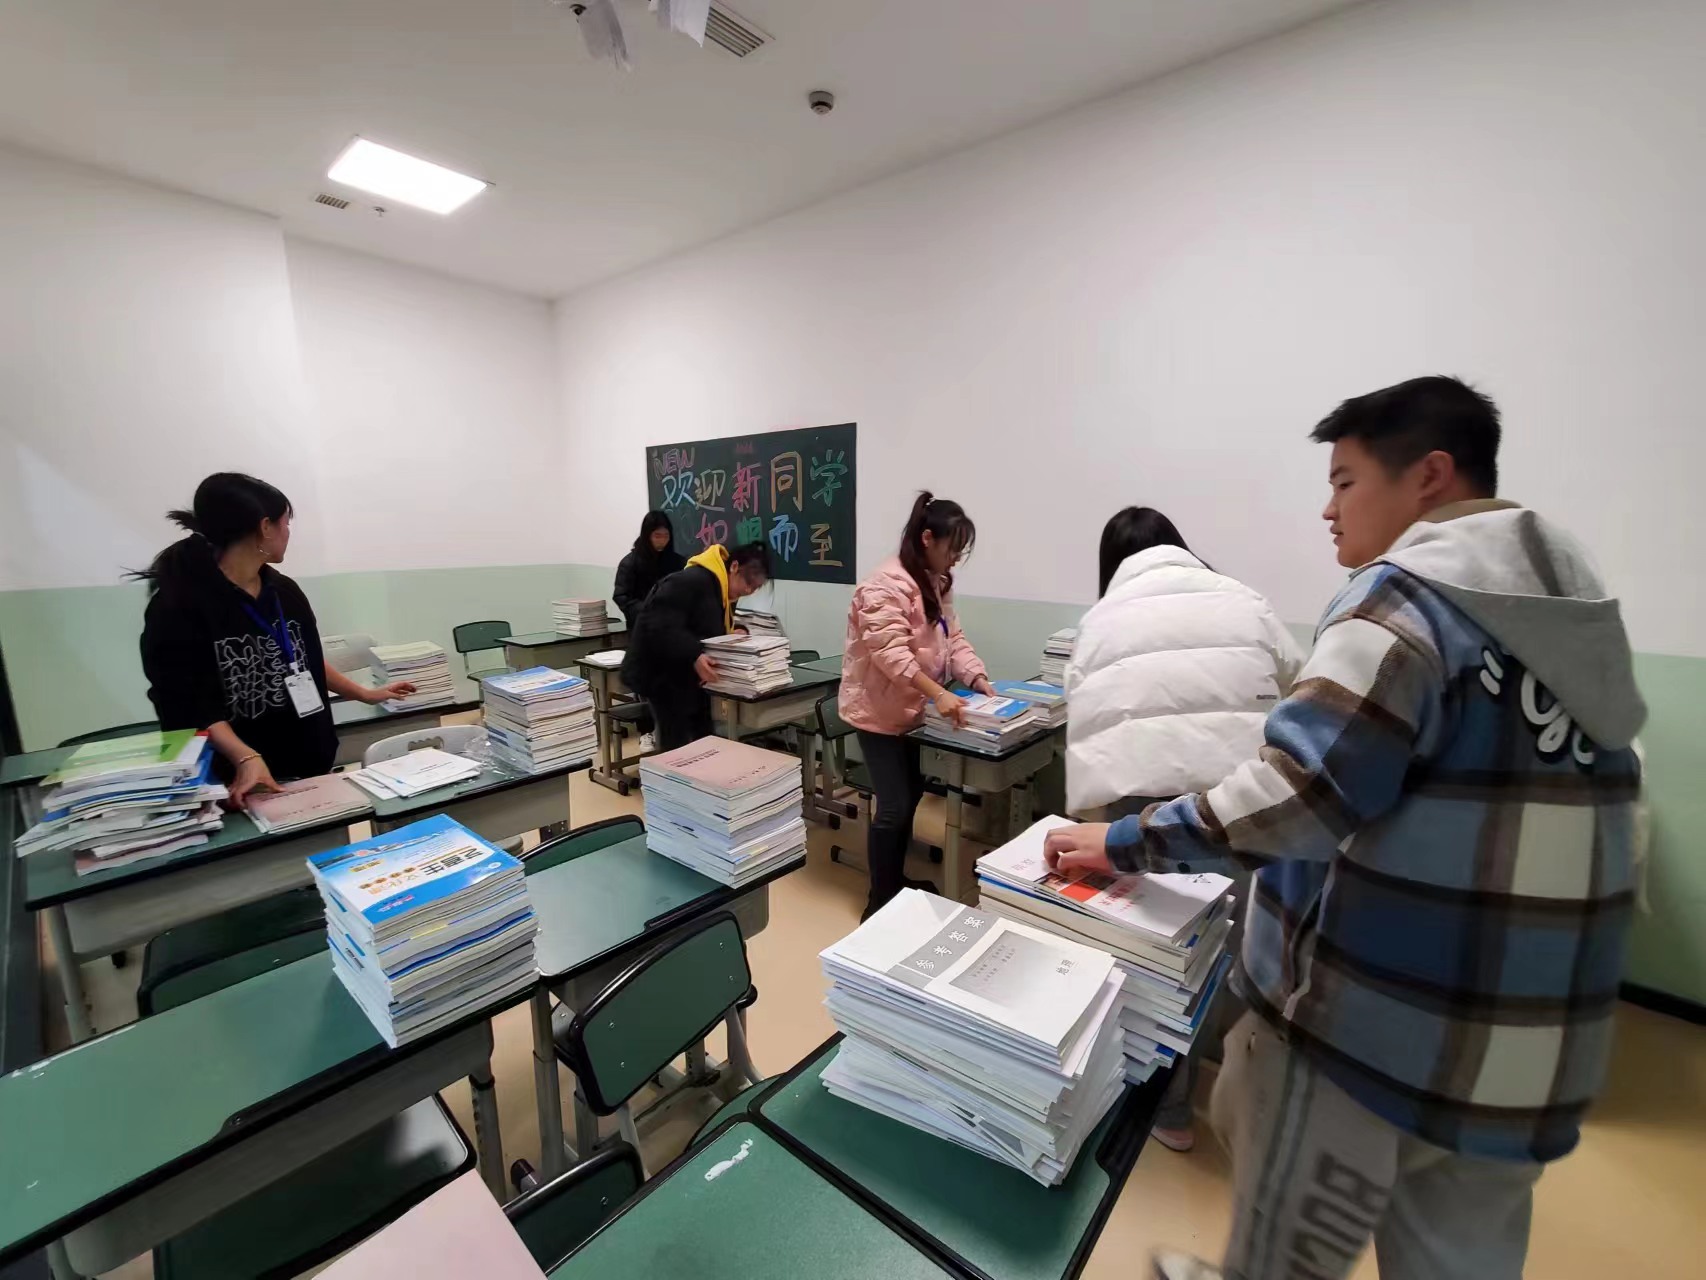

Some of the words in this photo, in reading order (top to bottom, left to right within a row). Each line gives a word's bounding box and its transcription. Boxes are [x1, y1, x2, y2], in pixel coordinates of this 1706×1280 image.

[660, 449, 848, 515] 欢迎新同学
[915, 916, 985, 970] 参考答案
